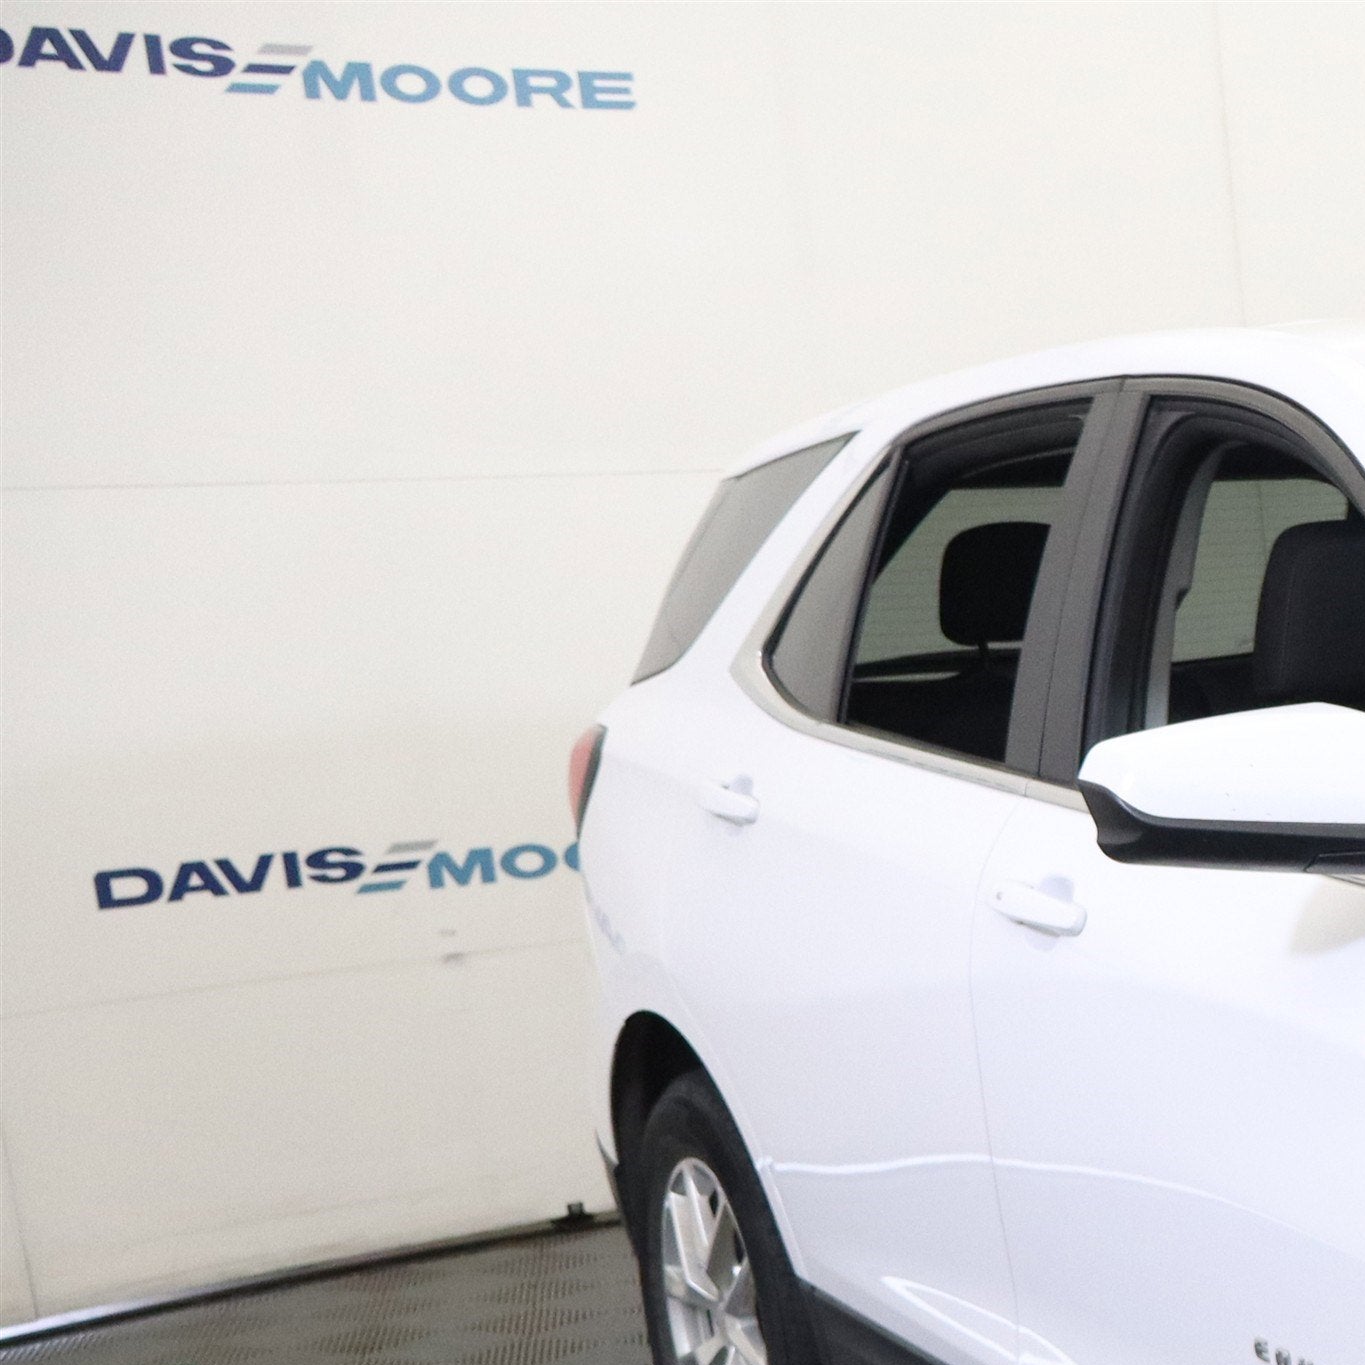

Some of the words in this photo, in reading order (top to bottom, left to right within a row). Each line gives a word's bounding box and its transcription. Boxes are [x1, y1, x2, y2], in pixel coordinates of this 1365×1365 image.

[0, 25, 237, 79] AVIS
[301, 59, 636, 111] MOORE
[93, 845, 368, 912] DAVIS
[426, 841, 578, 890] MO
